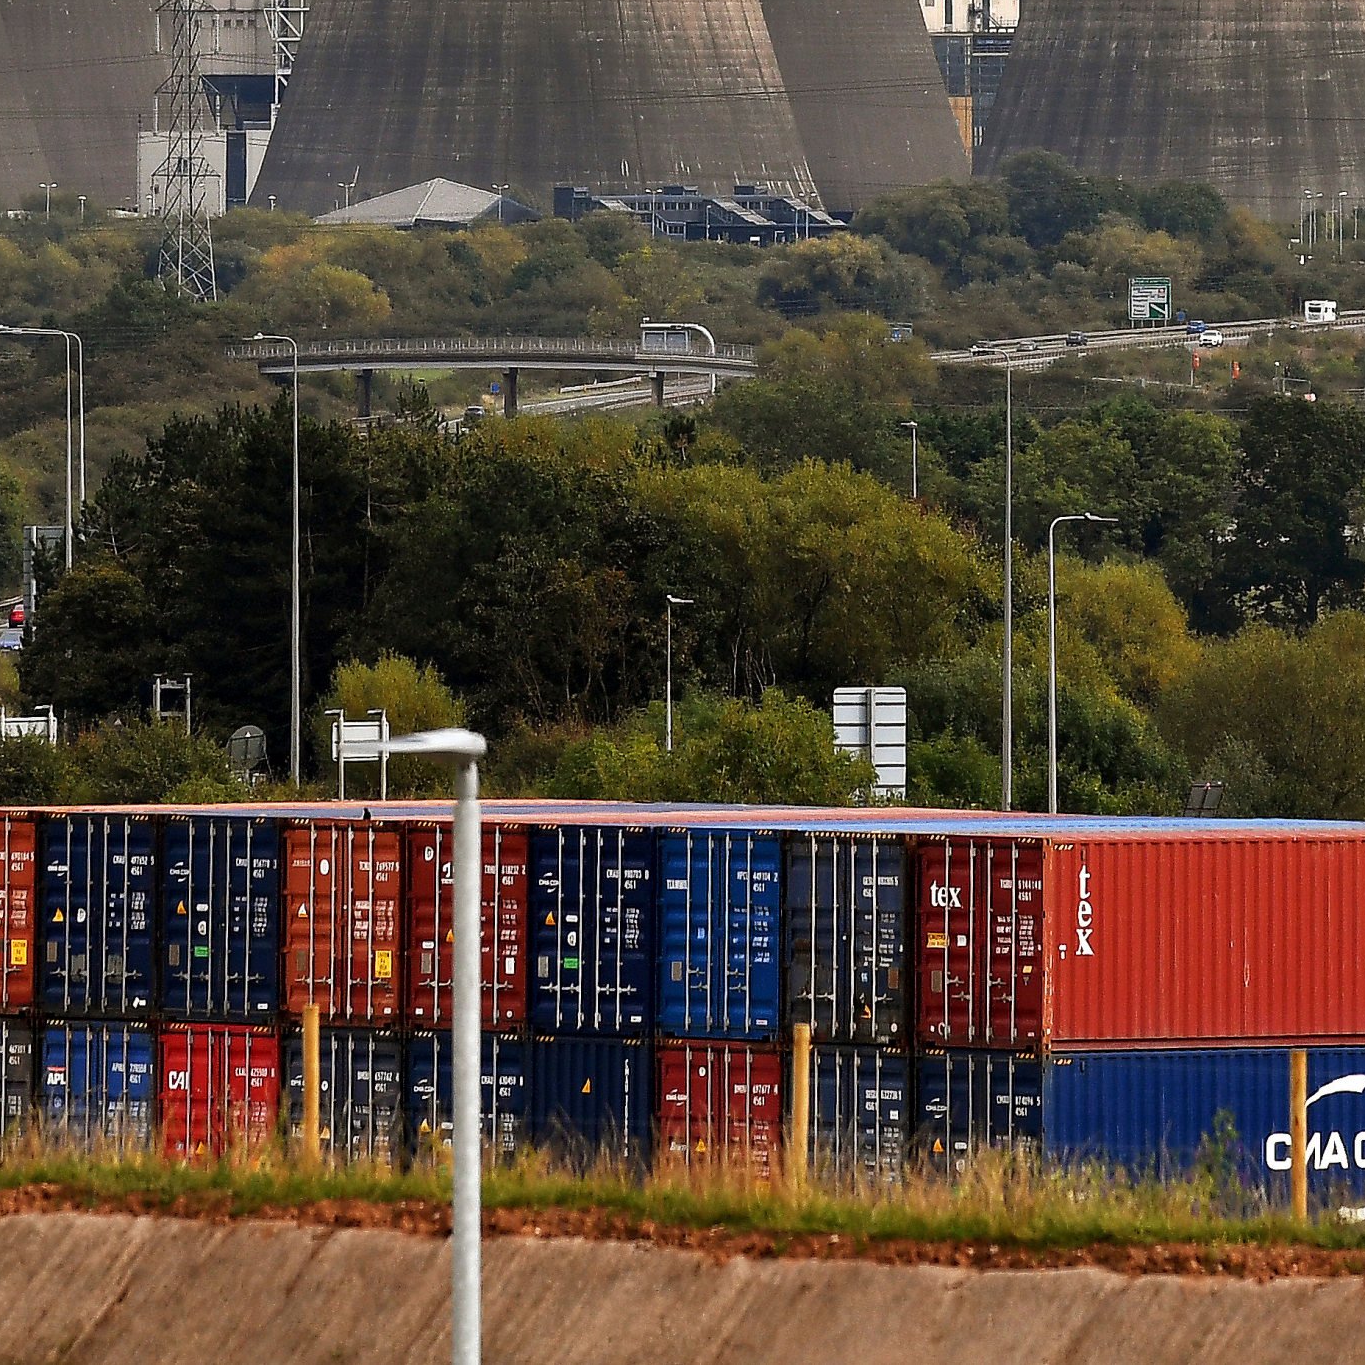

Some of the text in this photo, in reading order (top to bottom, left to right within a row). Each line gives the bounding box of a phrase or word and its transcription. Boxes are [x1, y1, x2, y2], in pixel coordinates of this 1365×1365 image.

[930, 880, 962, 908] tex
[1075, 865, 1094, 956] tex
[47, 1073, 67, 1085] APL
